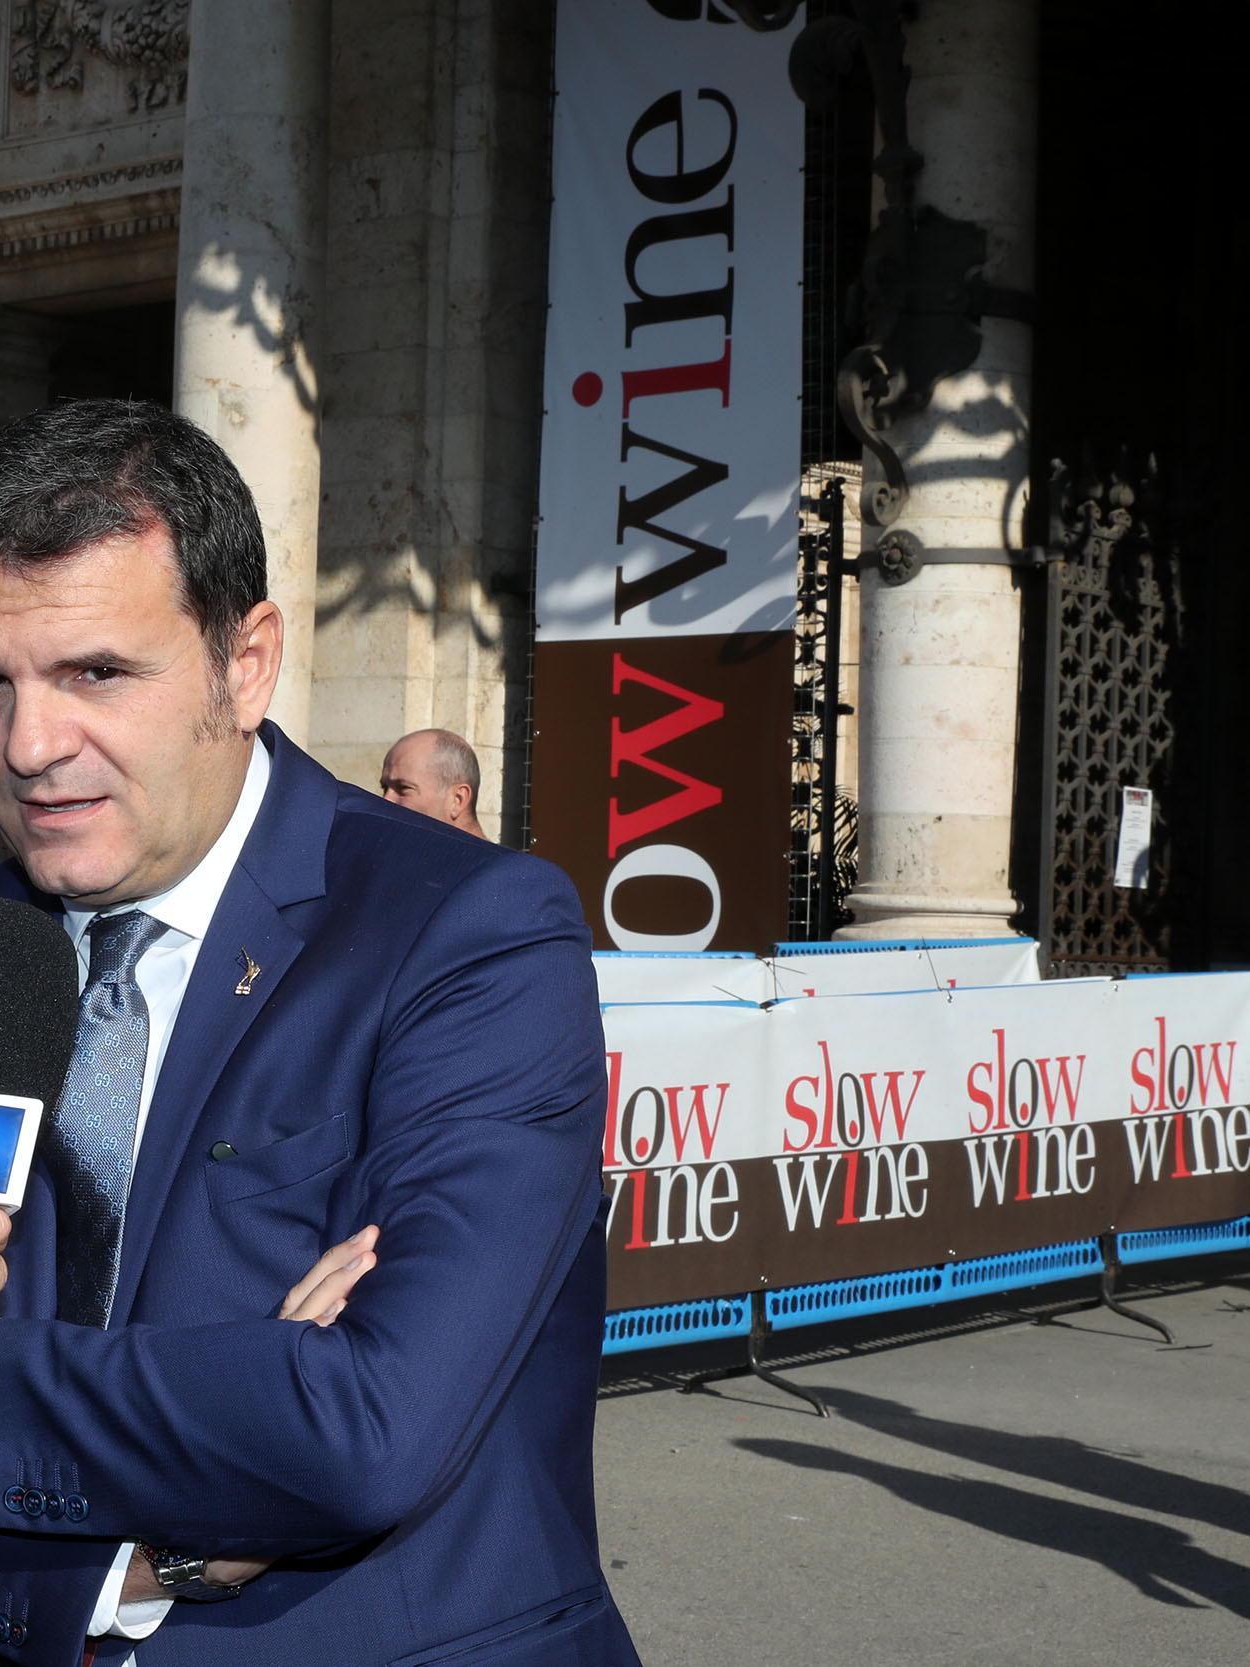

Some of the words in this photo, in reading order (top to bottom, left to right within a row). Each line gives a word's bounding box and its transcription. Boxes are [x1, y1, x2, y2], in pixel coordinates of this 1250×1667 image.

[572, 88, 738, 626] wine
[604, 652, 725, 951] ow
[603, 1051, 731, 1167] low
[783, 1040, 926, 1153] slow
[967, 1029, 1087, 1135] slow
[1129, 1016, 1237, 1116] slow
[772, 1143, 929, 1232] wine
[963, 1123, 1096, 1209] wine
[1123, 1105, 1250, 1185] wine
